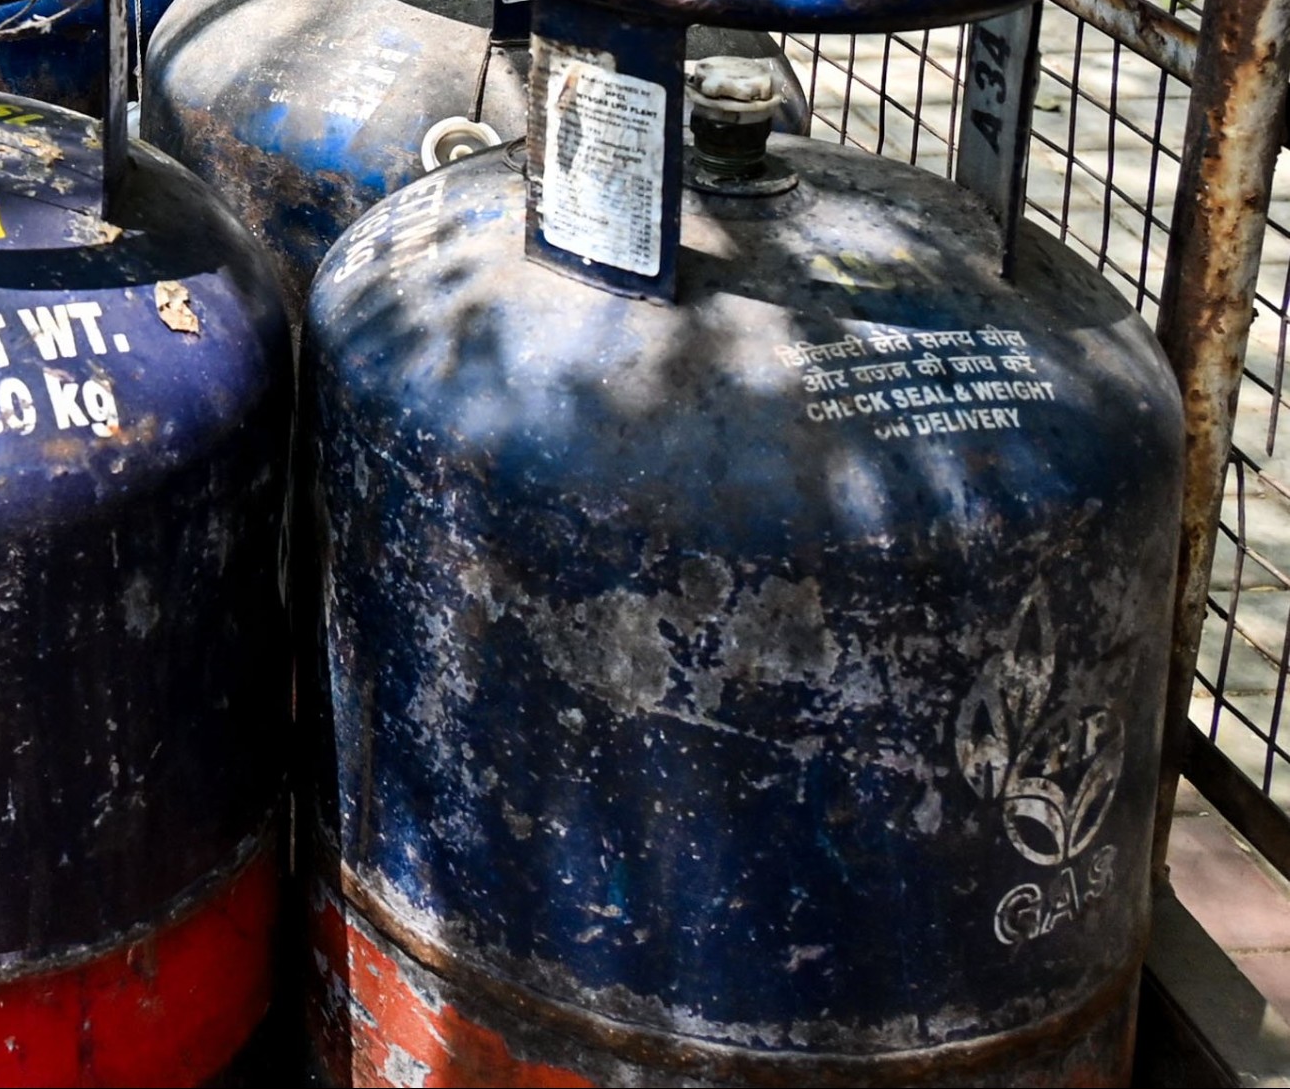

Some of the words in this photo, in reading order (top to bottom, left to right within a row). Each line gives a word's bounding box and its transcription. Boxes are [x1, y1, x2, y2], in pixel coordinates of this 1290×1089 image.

[18, 301, 131, 361] WT.
[914, 329, 976, 350] समय
[974, 324, 1028, 349] सील
[802, 365, 850, 394] और
[912, 352, 948, 377] की
[44, 367, 122, 438] kg
[890, 382, 955, 410] SEAL
[954, 380, 973, 403] &
[972, 381, 1057, 402] WEIGHT
[910, 407, 1022, 437] DELIVERY
